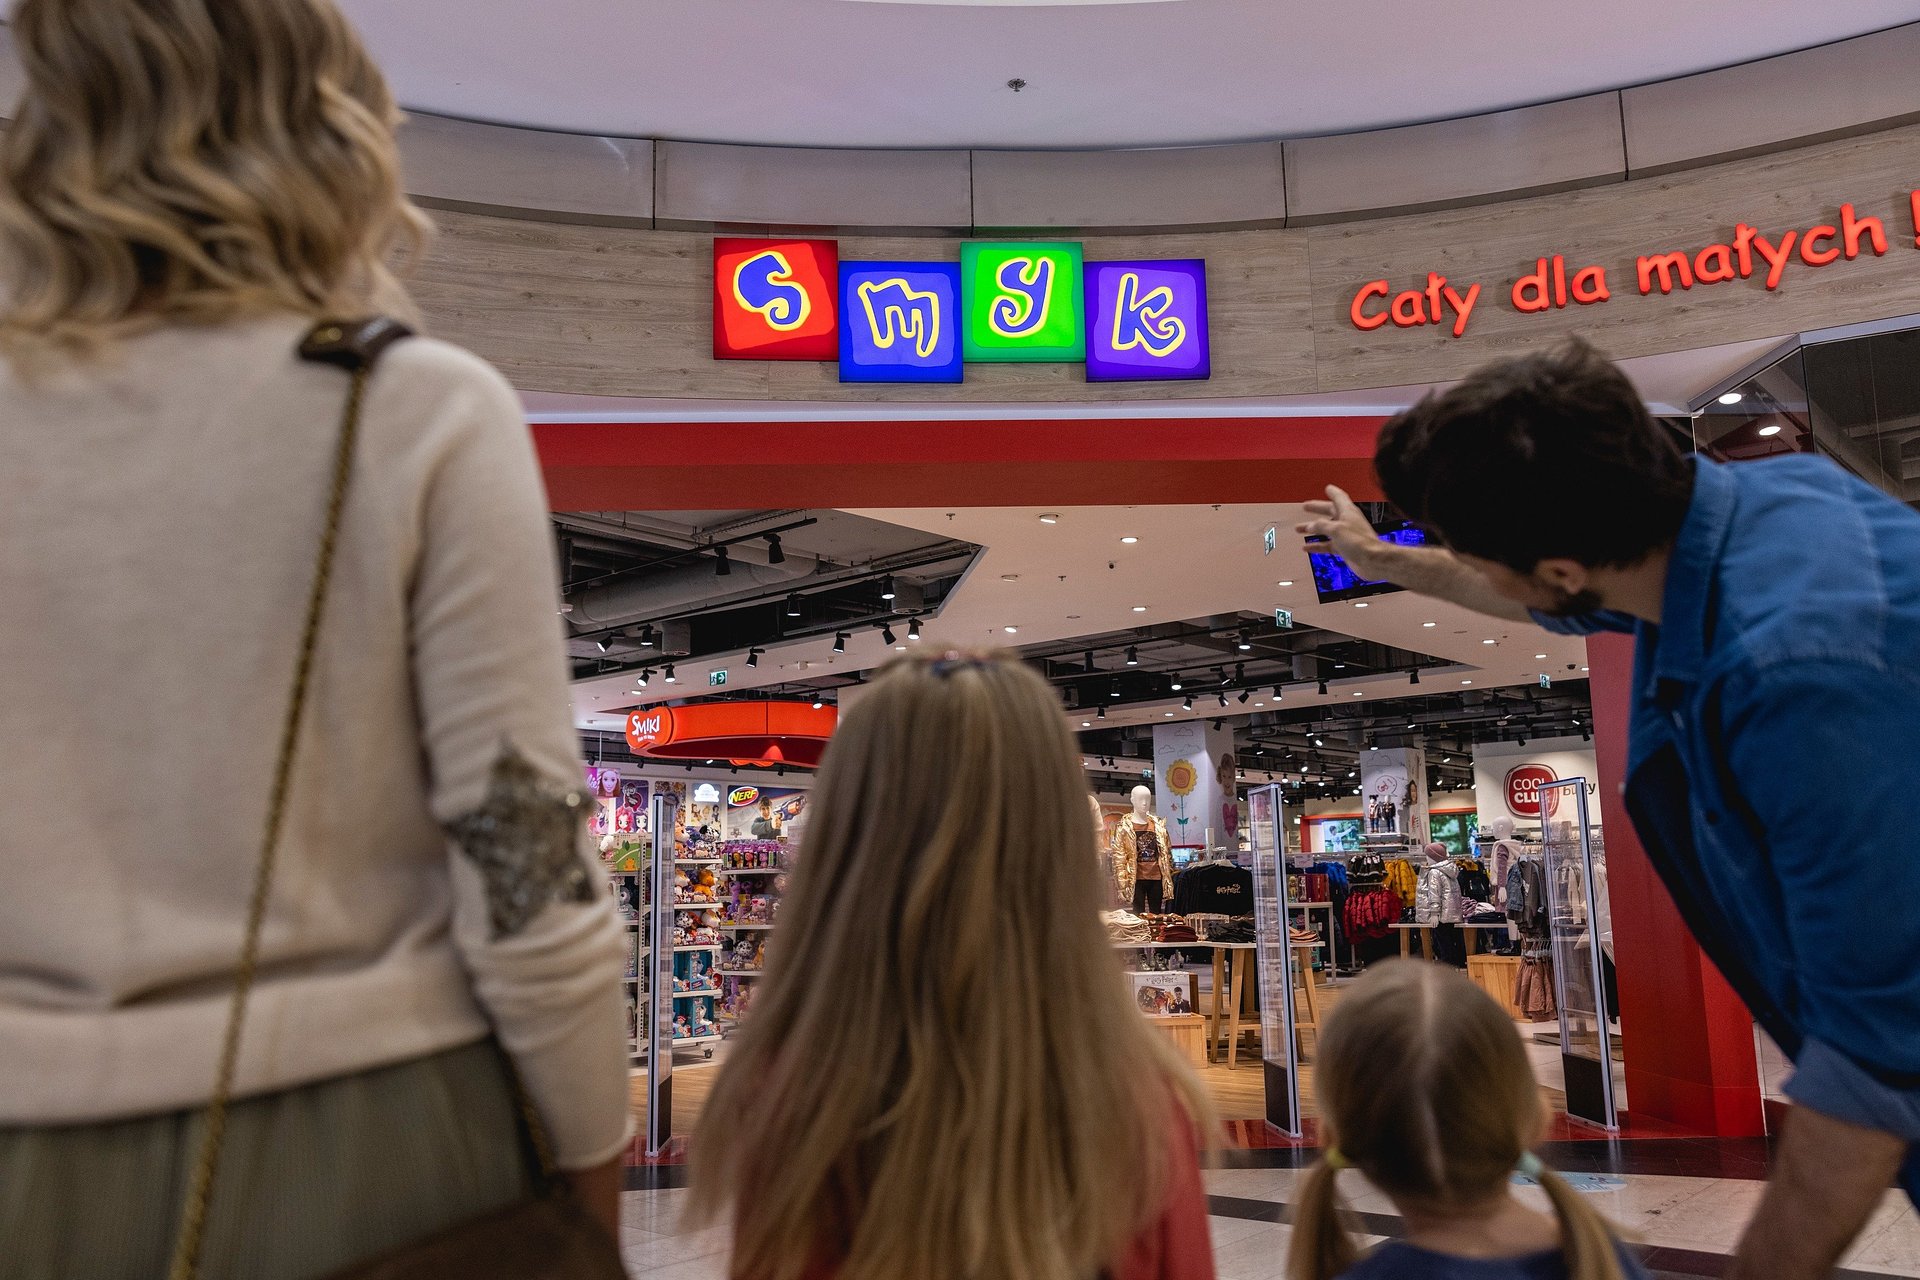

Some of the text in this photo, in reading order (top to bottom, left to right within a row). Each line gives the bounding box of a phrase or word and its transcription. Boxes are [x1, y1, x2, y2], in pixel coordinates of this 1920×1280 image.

[1350, 271, 1482, 338] Cały
[1511, 253, 1609, 314] dla
[1636, 202, 1889, 292] małych
[631, 714, 660, 736] SMIKI
[731, 789, 758, 803] NERF
[1514, 791, 1549, 804] CLU
